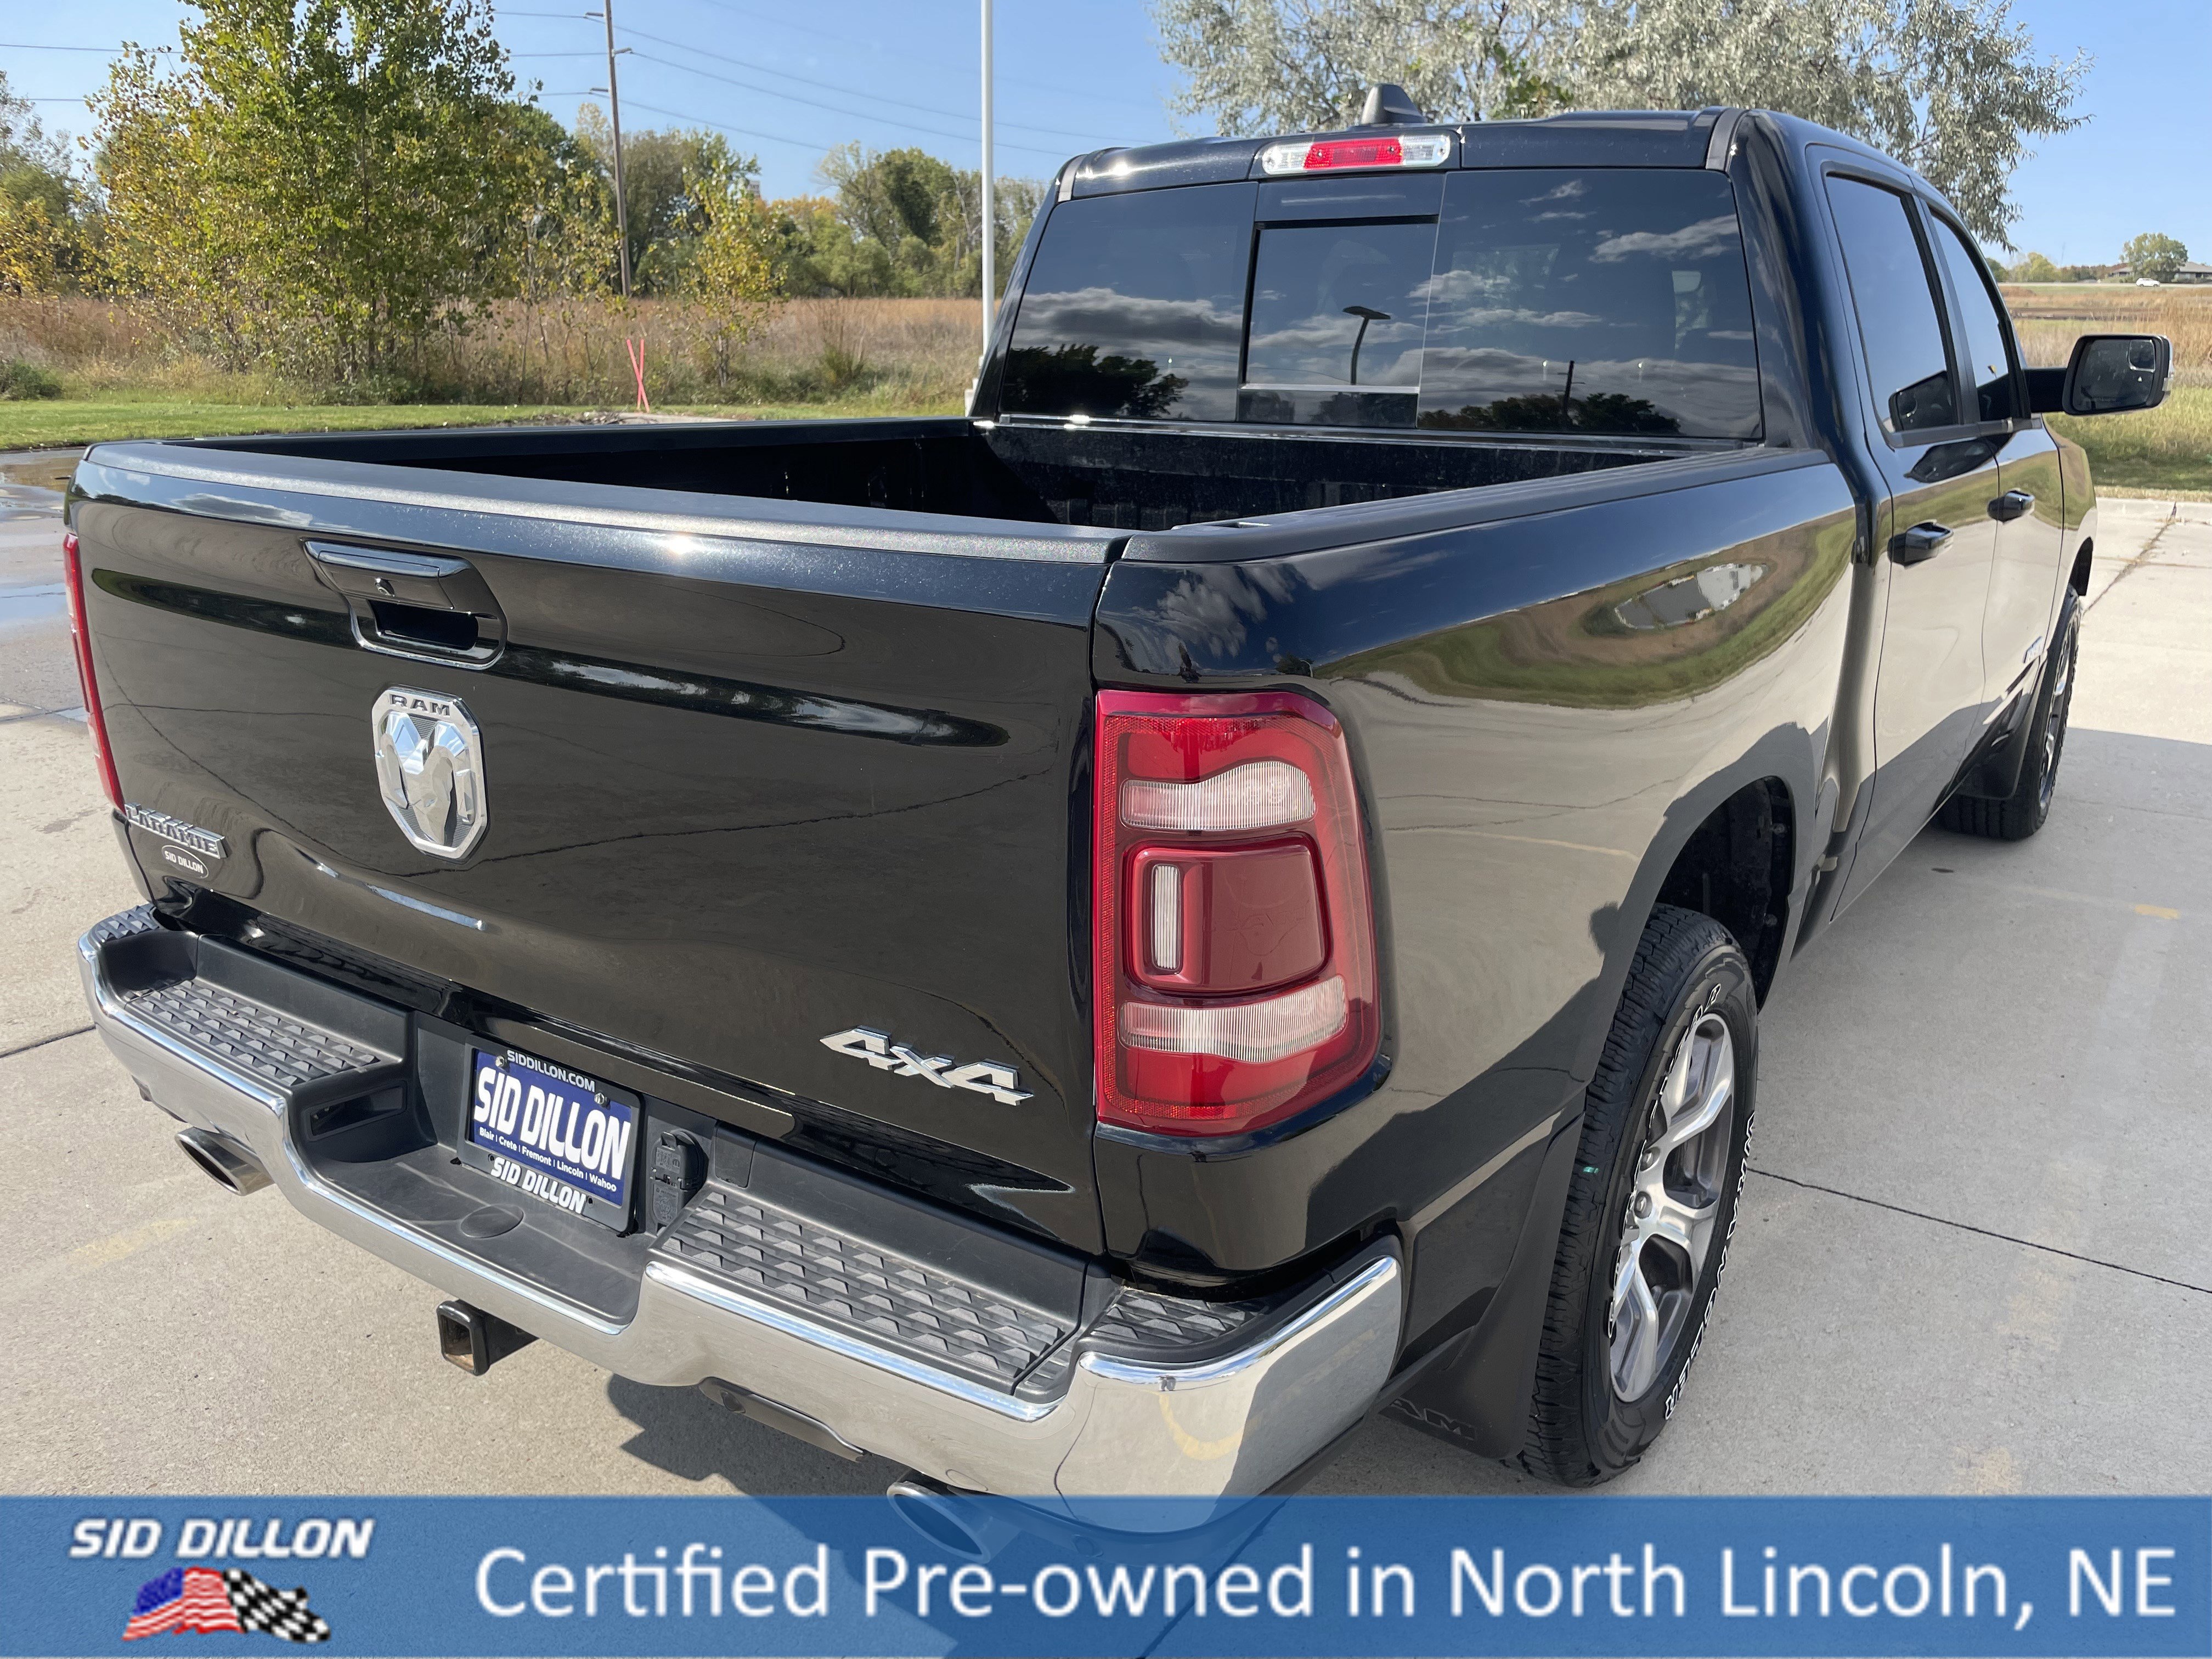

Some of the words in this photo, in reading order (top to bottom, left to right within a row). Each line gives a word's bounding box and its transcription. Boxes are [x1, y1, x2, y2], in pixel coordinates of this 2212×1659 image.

[389, 693, 452, 718] RAM
[164, 850, 177, 863] SID
[178, 855, 204, 874] DILLON
[506, 1049, 595, 1092] SIDDILLON.COM
[473, 1066, 522, 1136] SID
[520, 1085, 631, 1180] DILLON
[479, 1126, 495, 1141] Blair
[499, 1137, 517, 1152] Crete
[522, 1145, 552, 1167] Fremont
[557, 1160, 584, 1180] Lincoln
[589, 1173, 617, 1193] Wahoo
[490, 1156, 522, 1185] SID
[522, 1171, 587, 1215] DILLON
